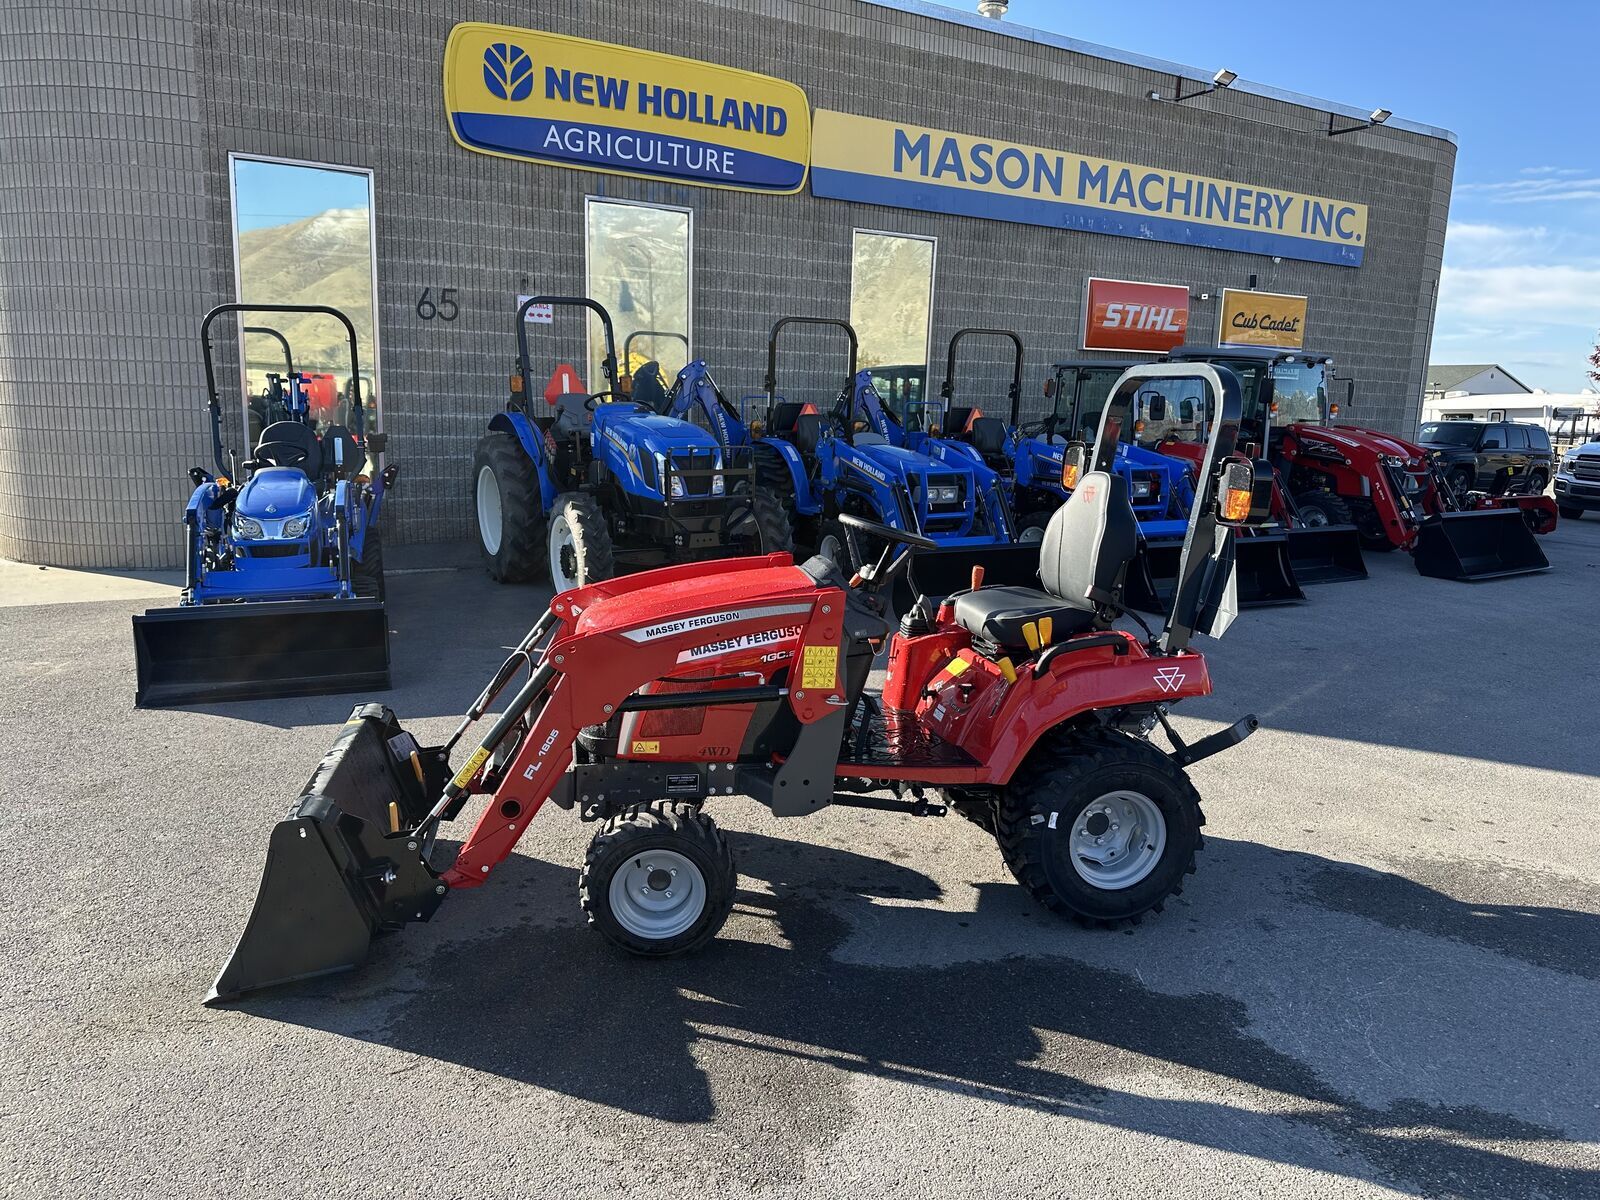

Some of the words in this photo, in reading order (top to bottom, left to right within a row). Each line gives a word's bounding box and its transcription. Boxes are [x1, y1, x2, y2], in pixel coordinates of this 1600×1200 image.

[545, 66, 629, 111] NEW
[638, 83, 788, 137] HOLLAND
[543, 124, 735, 175] AGRICULTURE
[893, 128, 1064, 198] MASON
[1078, 160, 1294, 231] MACHINERY
[1300, 201, 1362, 242] INC.
[417, 287, 458, 321] 65
[1102, 303, 1180, 332] STIHL
[1232, 311, 1258, 329] Cub
[1260, 314, 1300, 333] Cadet
[852, 456, 863, 469] NEW
[863, 461, 886, 481] HOLLAND
[646, 621, 685, 638] MASSEY
[688, 612, 740, 628] FERGUSON
[690, 635, 745, 657] MASSEY
[523, 761, 543, 780] FL
[538, 729, 560, 757] 1805
[698, 746, 731, 757] 4WD
